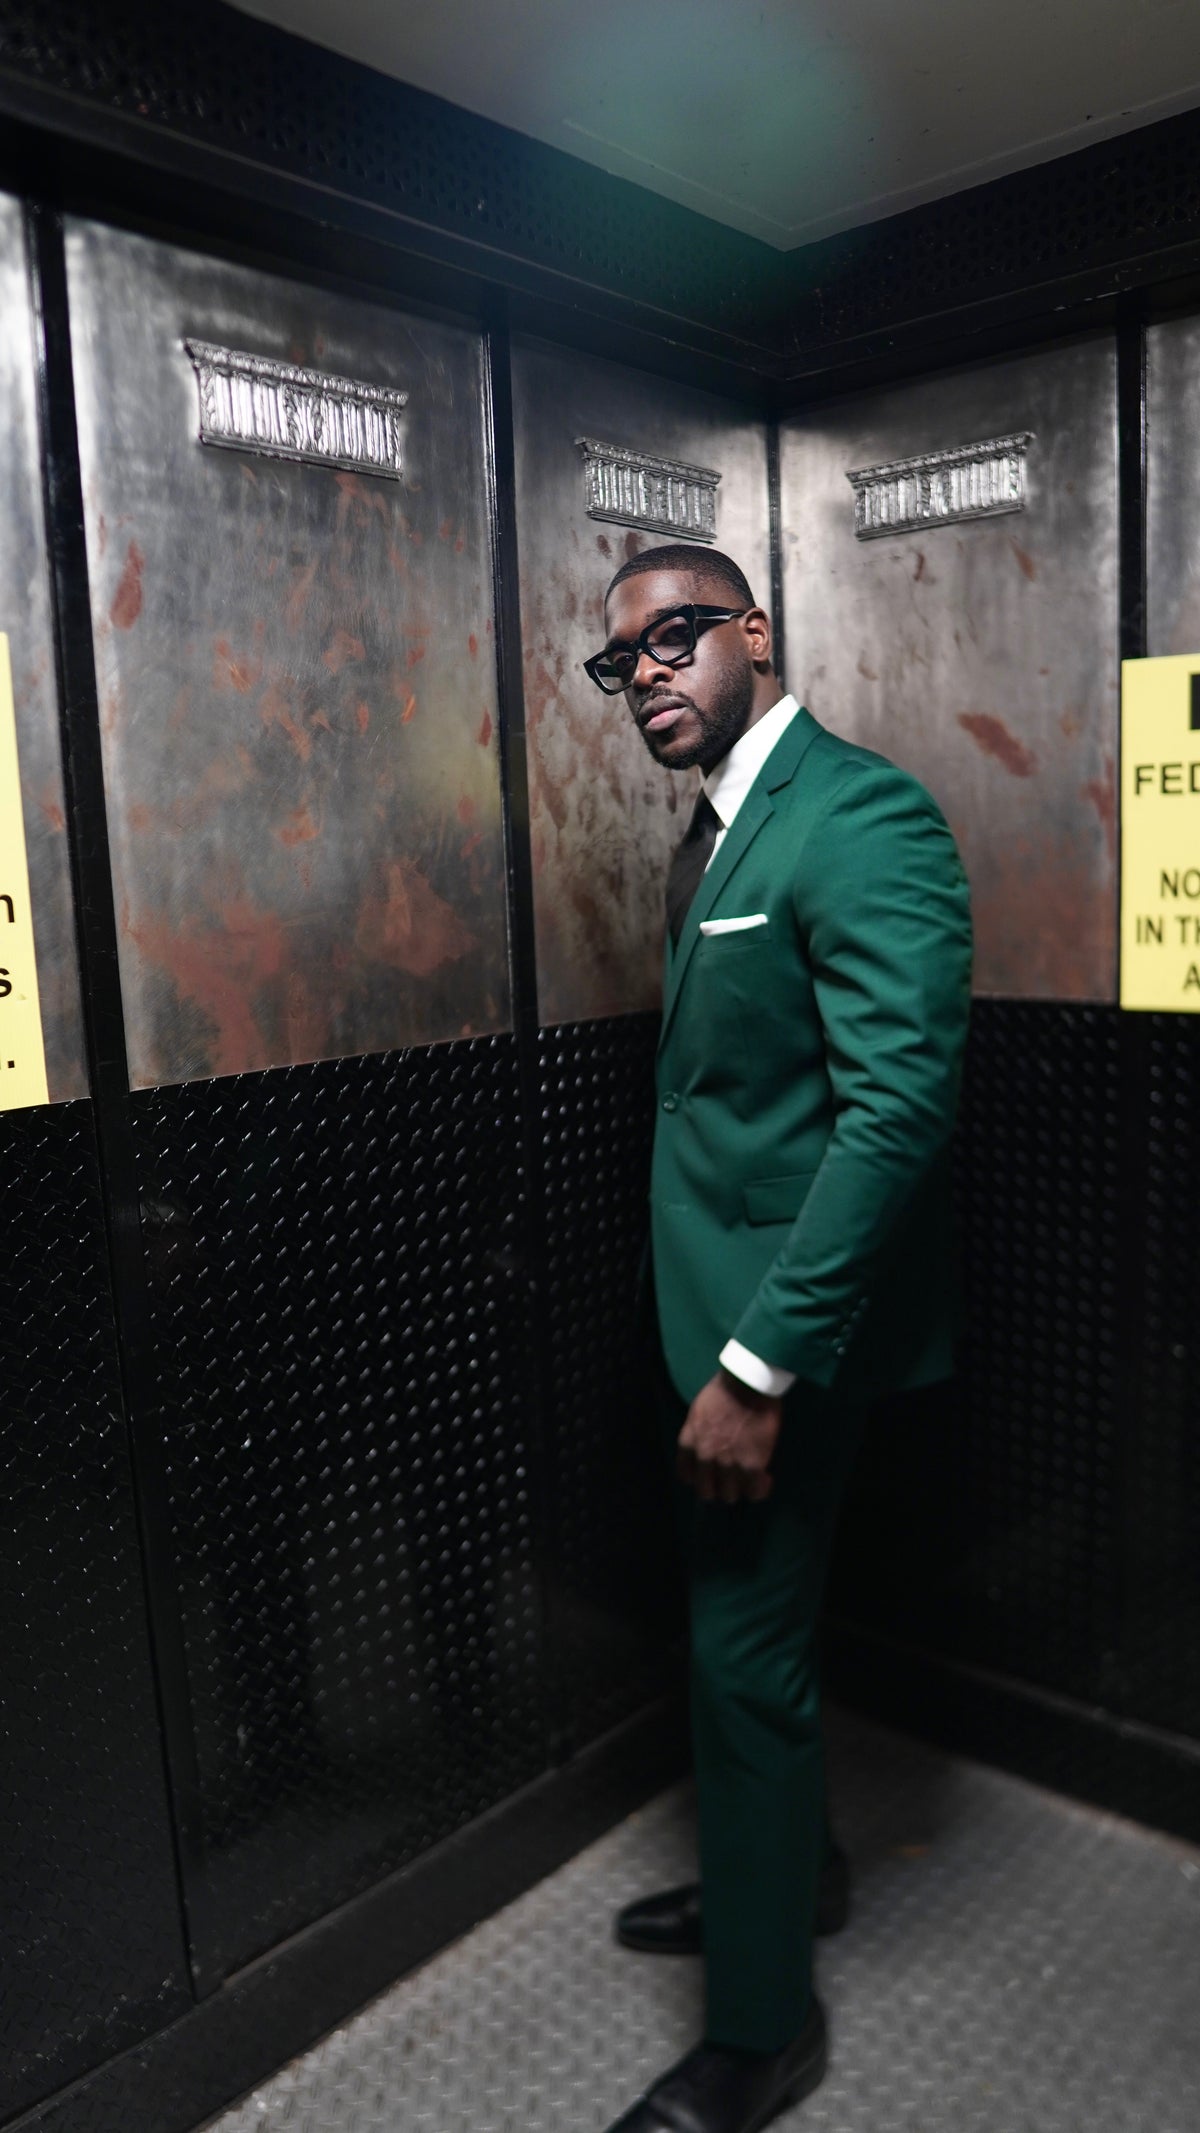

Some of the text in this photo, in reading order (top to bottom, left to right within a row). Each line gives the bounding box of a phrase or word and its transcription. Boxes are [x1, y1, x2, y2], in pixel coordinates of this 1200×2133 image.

[1160, 868, 1200, 898] NO
[1136, 915, 1200, 944] IN T
